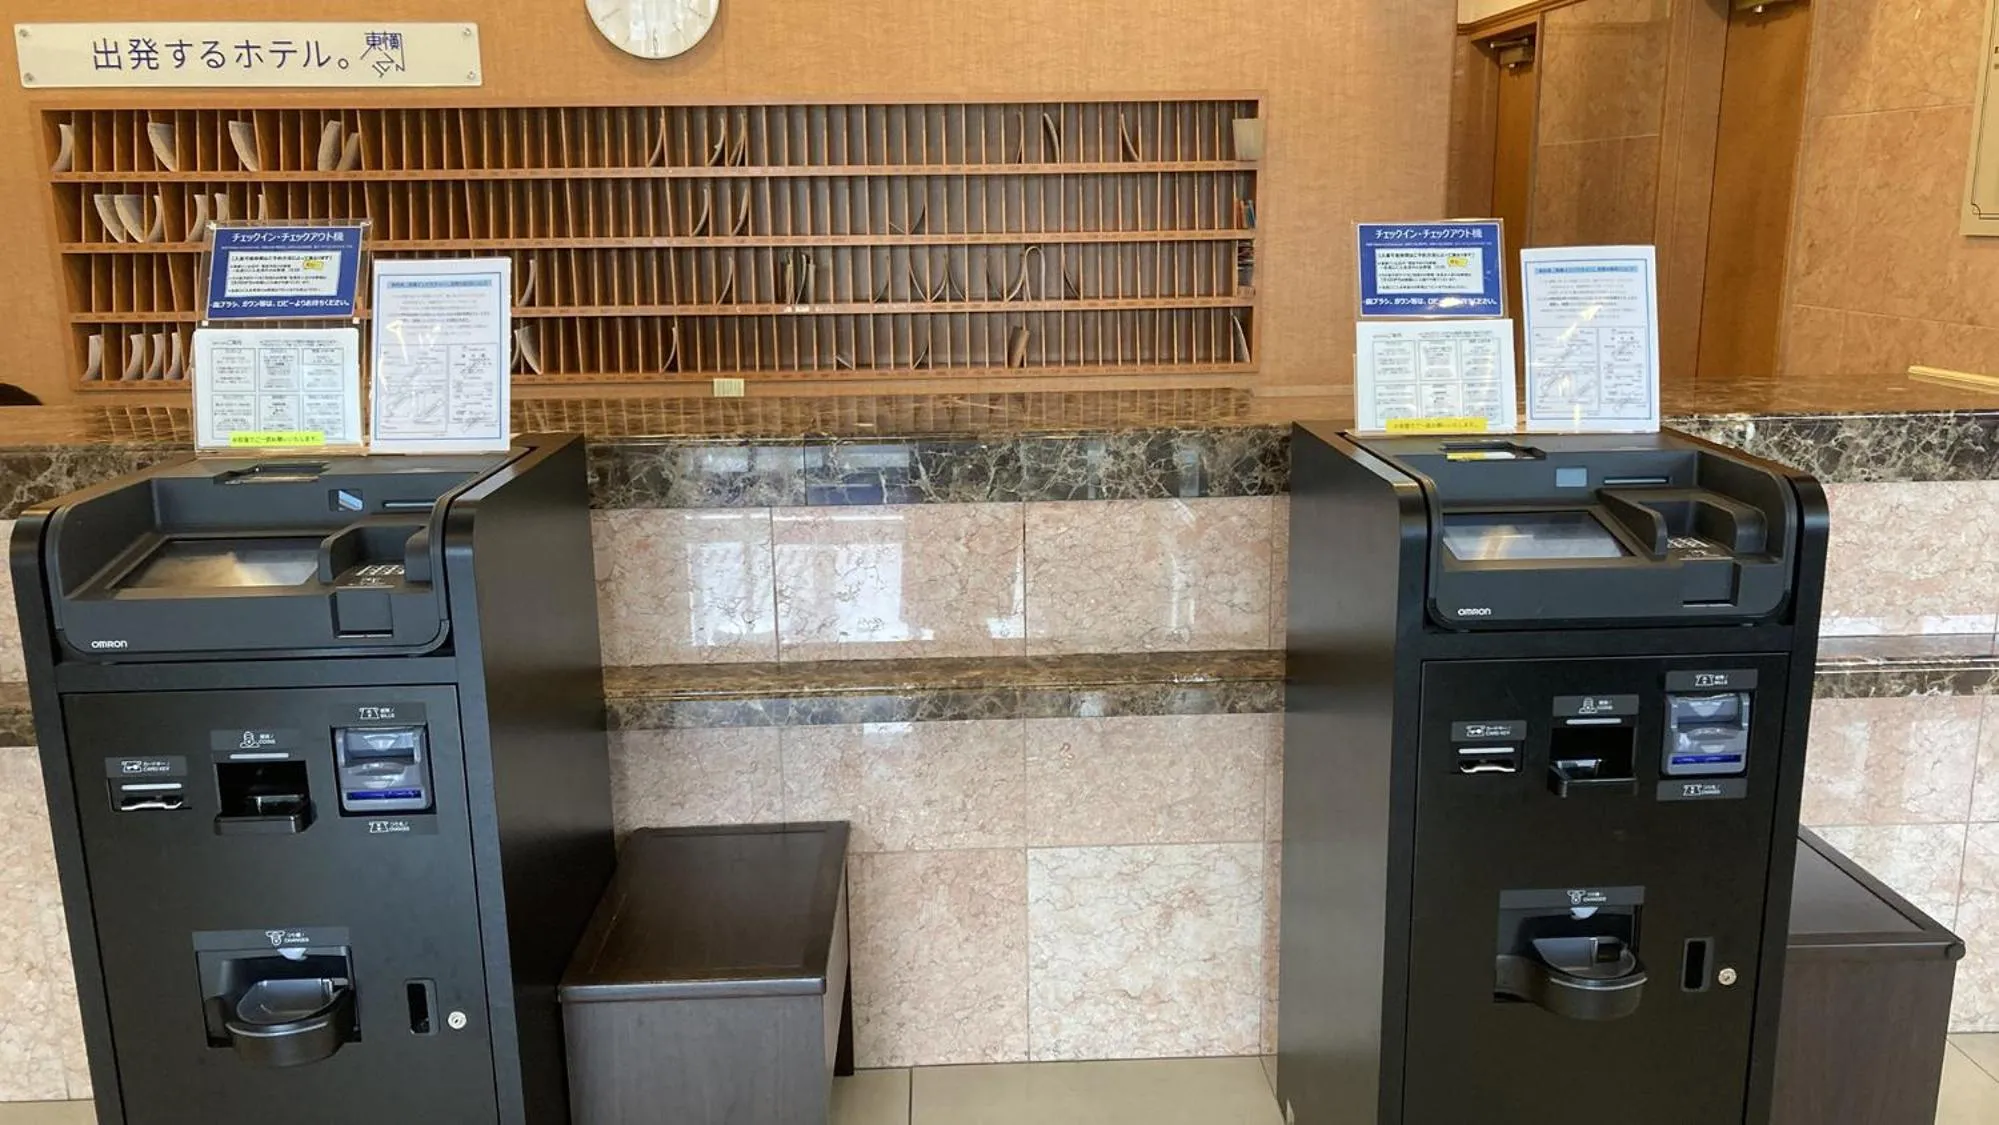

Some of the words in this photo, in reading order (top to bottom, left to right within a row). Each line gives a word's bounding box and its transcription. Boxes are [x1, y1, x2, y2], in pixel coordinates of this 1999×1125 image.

[91, 37, 350, 71] 出発するホテル。
[231, 231, 345, 243] チェックイン・チェックアウト機
[1375, 228, 1483, 240] チェックイン・チェックアウト機
[1457, 607, 1491, 616] OMRON
[91, 640, 128, 649] OMRON
